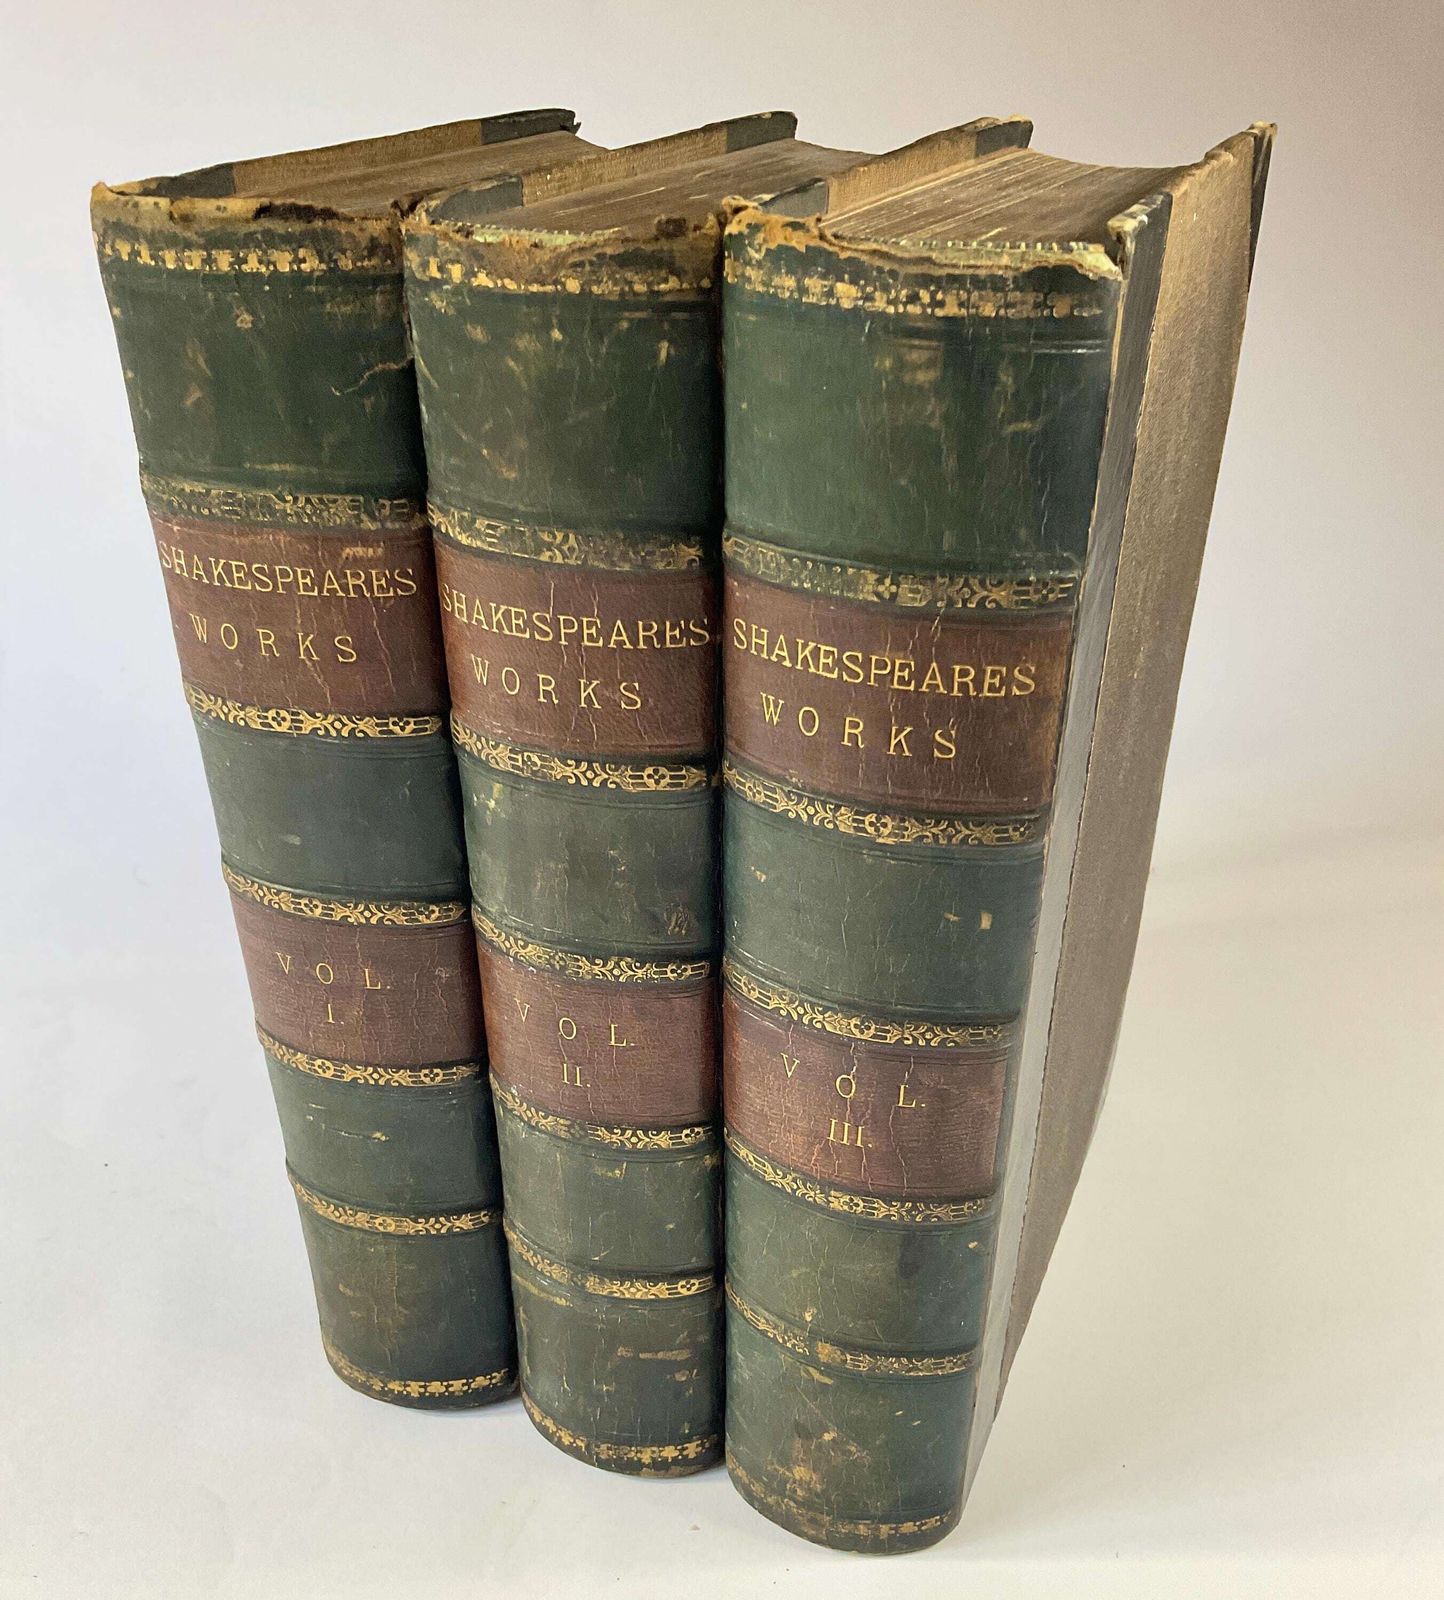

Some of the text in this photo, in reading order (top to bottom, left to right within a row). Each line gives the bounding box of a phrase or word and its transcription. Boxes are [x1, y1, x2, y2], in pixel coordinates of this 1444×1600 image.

[190, 613, 358, 663] WORKS
[733, 618, 1037, 698] SHAKESPEARES
[471, 653, 642, 710] WORKS
[760, 692, 957, 759] WORKS
[327, 1003, 345, 1025] I.
[561, 1063, 591, 1088] II.
[826, 1118, 873, 1149] III.
